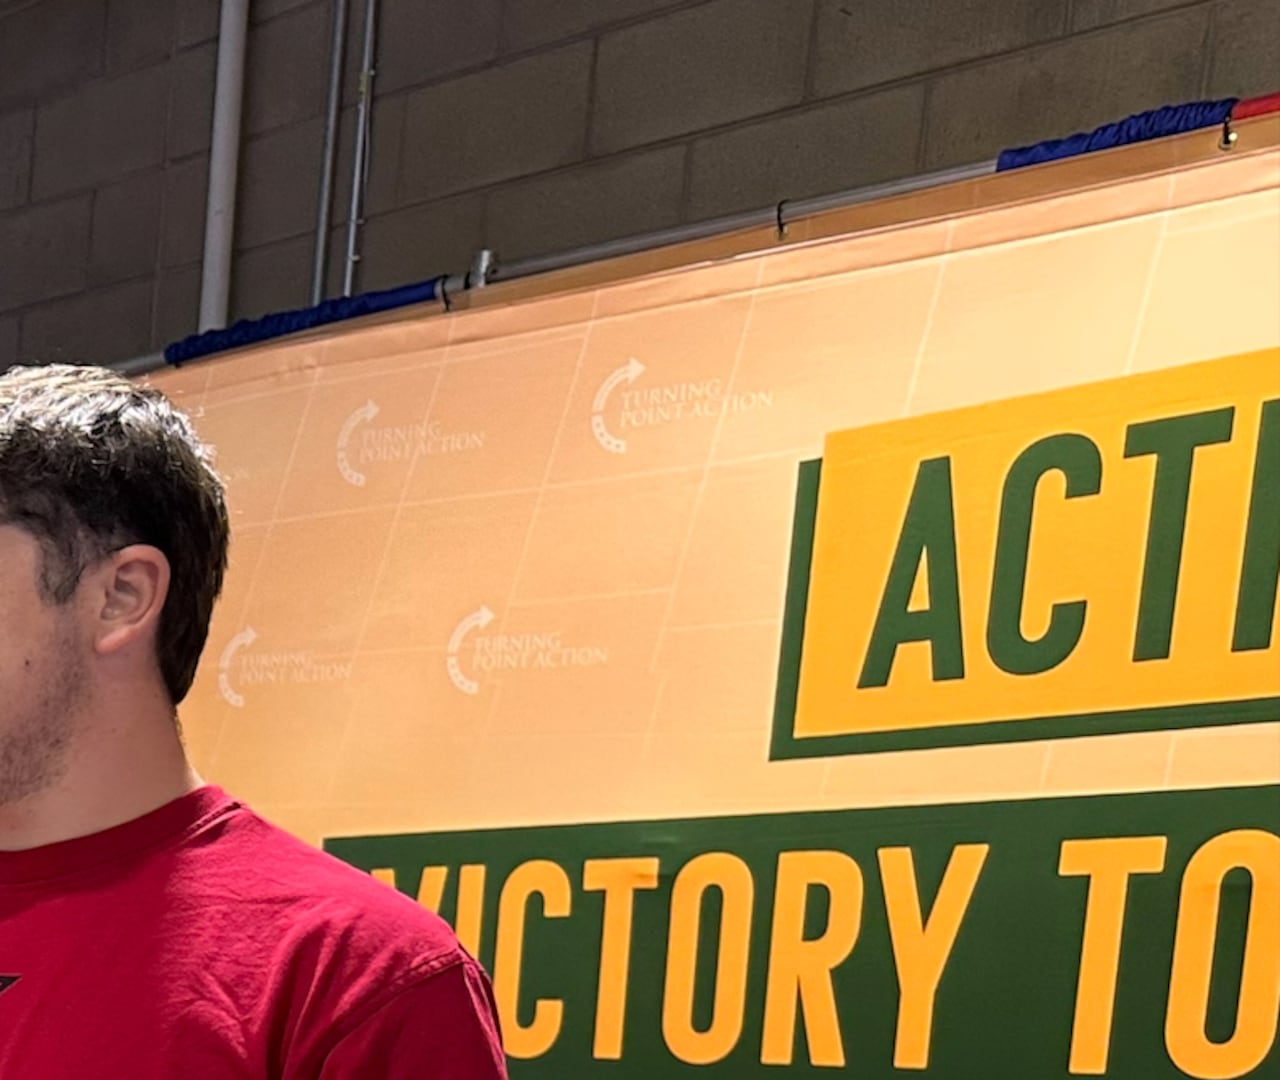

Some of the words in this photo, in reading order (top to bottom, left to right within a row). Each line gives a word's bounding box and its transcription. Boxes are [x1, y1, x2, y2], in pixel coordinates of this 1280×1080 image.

[618, 402, 688, 430] POINT
[690, 390, 775, 420] ACTION
[620, 377, 722, 410] TURNING
[358, 440, 413, 464] POINT
[412, 431, 486, 457] ACTION
[361, 419, 441, 447] TURNING
[472, 650, 535, 671] POINT
[533, 645, 609, 669] ACTION
[473, 630, 562, 653] TURNING
[371, 826, 989, 1069] ICTORY
[1055, 830, 1280, 1080] TO
